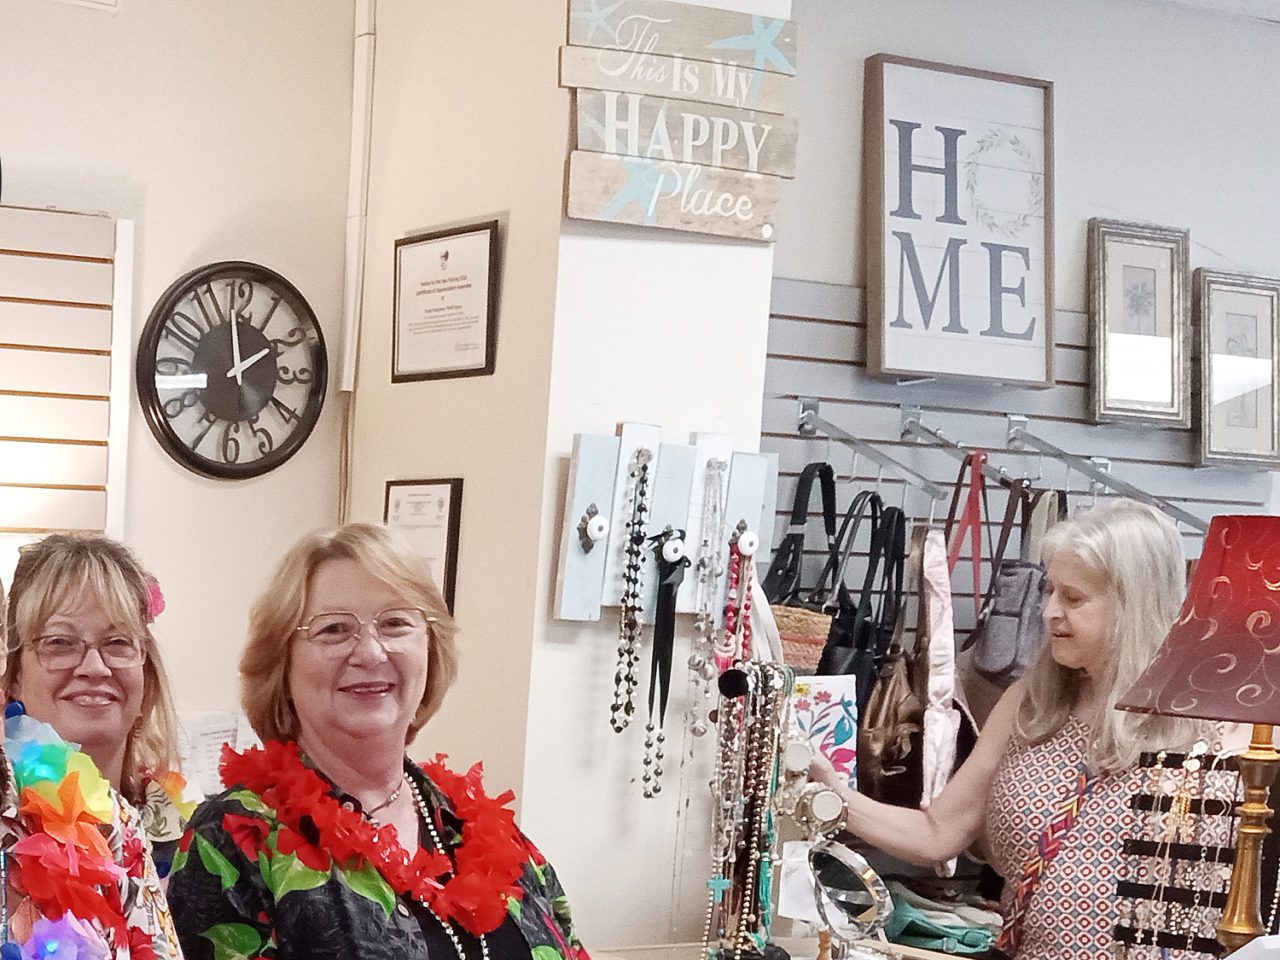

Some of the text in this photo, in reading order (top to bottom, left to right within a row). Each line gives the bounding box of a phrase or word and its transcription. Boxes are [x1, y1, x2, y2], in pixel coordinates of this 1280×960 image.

[598, 14, 672, 81] This
[712, 58, 754, 109] My
[602, 91, 773, 180] HAPPY
[647, 163, 755, 221] Place
[889, 230, 1037, 342] ME
